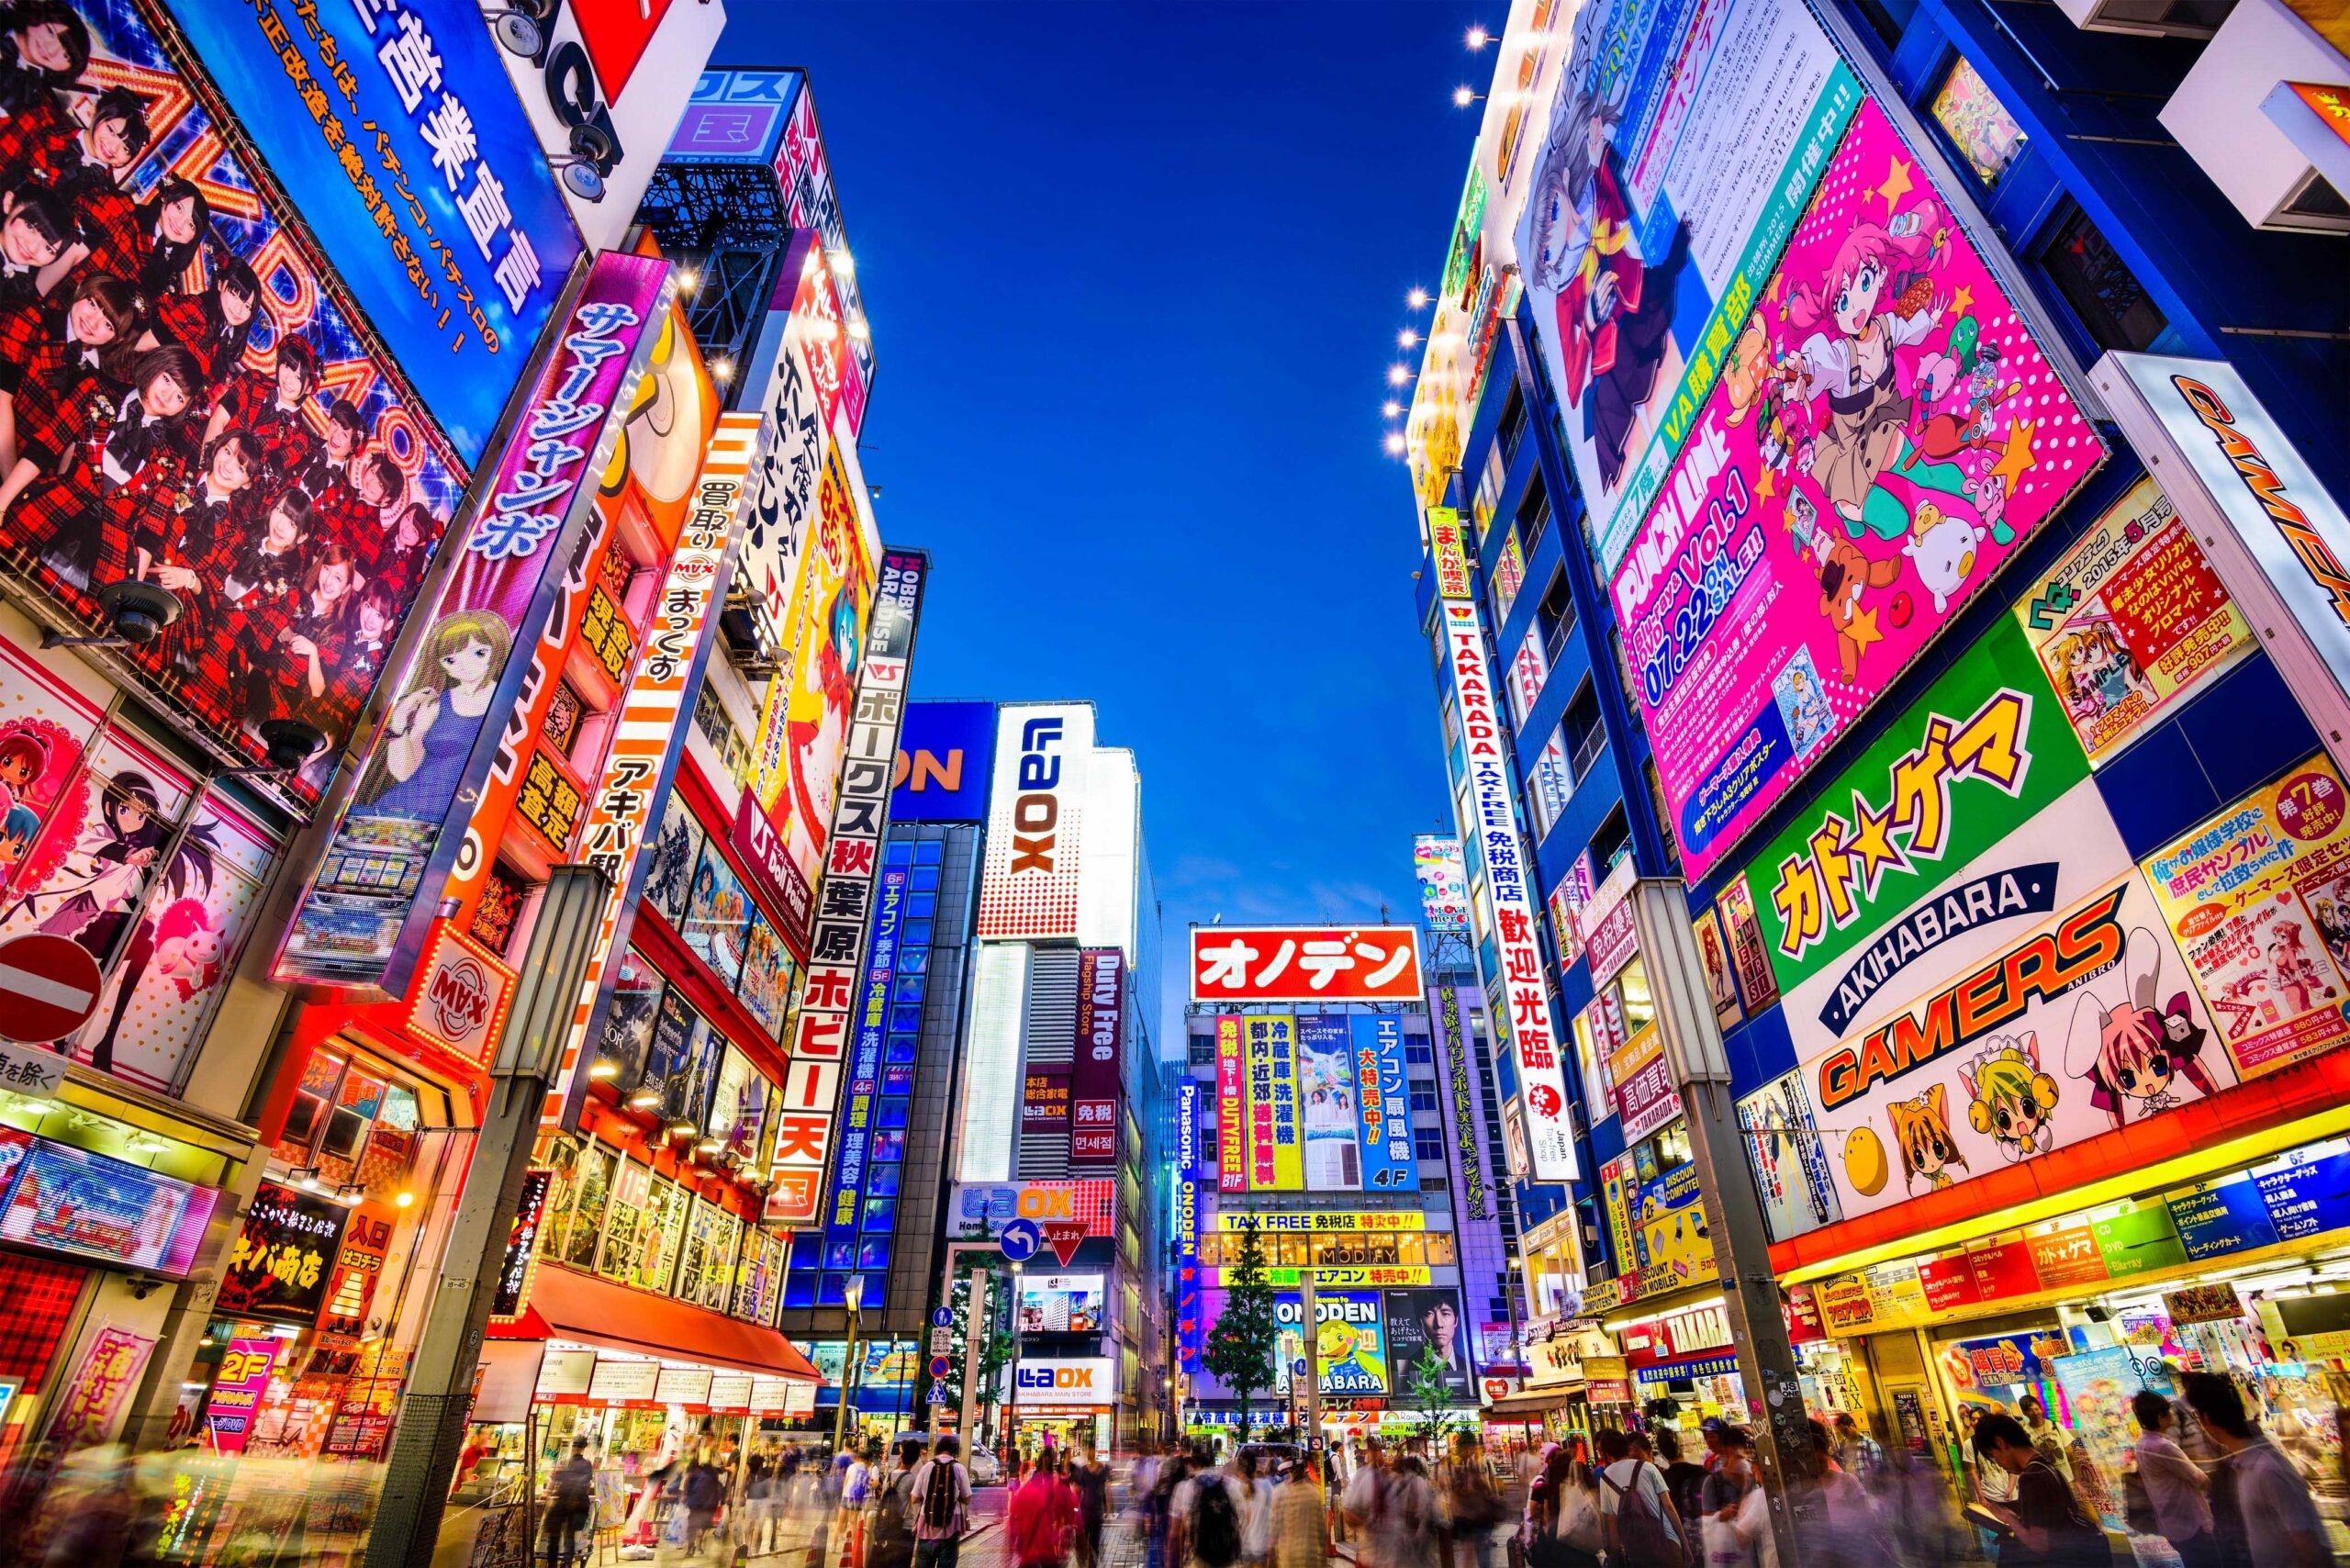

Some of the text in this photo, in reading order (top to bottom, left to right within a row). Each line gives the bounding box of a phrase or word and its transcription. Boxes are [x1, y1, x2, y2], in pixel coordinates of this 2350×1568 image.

[293, 0, 500, 353] たちは、パチンコ・パチスロの
[354, 0, 541, 316] 営業宣言
[1767, 202, 1788, 239] 2015
[470, 302, 640, 561] サマージャンボ
[688, 481, 738, 551] 買取り
[1680, 468, 1749, 587] Vol.1
[1434, 524, 1469, 596] まんが喫茶
[1706, 556, 1730, 595] ON
[1711, 527, 1764, 620] SALE!!
[869, 555, 901, 654] PARADISE
[899, 556, 921, 623] HOBBY
[2141, 574, 2196, 626] オリジナル
[646, 588, 703, 684] まっくす
[1638, 624, 1664, 672] DVD
[1643, 588, 1716, 708] 07.22
[1453, 633, 1497, 756] TAKARADA
[2071, 651, 2129, 708] SAMPLE
[2300, 803, 2326, 823] 好評
[886, 874, 904, 883] 6F
[1485, 830, 1524, 902] 免税商店
[768, 851, 806, 921] Doll Point
[872, 885, 901, 969] エアコン・季節
[1838, 872, 2025, 1019] AKIHABARA
[1198, 931, 1411, 991] オノデン
[1606, 936, 1636, 976] TAKARADA
[871, 971, 890, 981] 5F
[1497, 908, 1556, 1070] 歓迎光臨
[2067, 959, 2117, 991] ANIBRO
[2269, 959, 2331, 991] SAMPLE
[1080, 956, 1094, 1036] Flagship Store
[1091, 955, 1120, 1060] Duty Free
[1820, 885, 2127, 1111] GAMERS
[856, 982, 887, 1080] 冷蔵庫・洗濯機
[1219, 1021, 1237, 1057] 免税
[854, 1081, 874, 1093] 4F
[1024, 1088, 1069, 1100] 総合家電
[1025, 1077, 1048, 1088] 本店
[1078, 1104, 1113, 1122] 免税
[1181, 1085, 1194, 1170] Panasonic
[1640, 1098, 1673, 1131] TAKARADA
[834, 1095, 870, 1226] 調理・理美容・健康
[1075, 1137, 1113, 1150] 면세점
[1538, 1139, 1548, 1162] Shop
[1546, 1126, 1557, 1161] Tax-free
[1556, 1129, 1566, 1162] Japan.
[2289, 1152, 2305, 1166] 6F
[347, 1214, 391, 1249] 入口
[1052, 1230, 1080, 1241] 止まれ
[1182, 1181, 1194, 1255] ONODEN
[1226, 1215, 1260, 1228] TAX
[1266, 1215, 1312, 1229] FREE
[1315, 1215, 1356, 1228] 免税店
[340, 1249, 383, 1271] はコチラ
[1323, 1249, 1395, 1264] MODIFY
[1637, 1261, 1669, 1282] DISCOUNT
[1315, 1270, 1365, 1282] エアコン
[1582, 1283, 1606, 1298] DISCOUNT
[1634, 1273, 1679, 1297] GSM MOBILES
[1823, 1285, 1864, 1302] GAMERS
[1390, 1317, 1411, 1327] 教えて
[1582, 1295, 1613, 1313] COMPUTERS
[218, 1352, 269, 1383] 2F
[1783, 1382, 1796, 1391] JS
